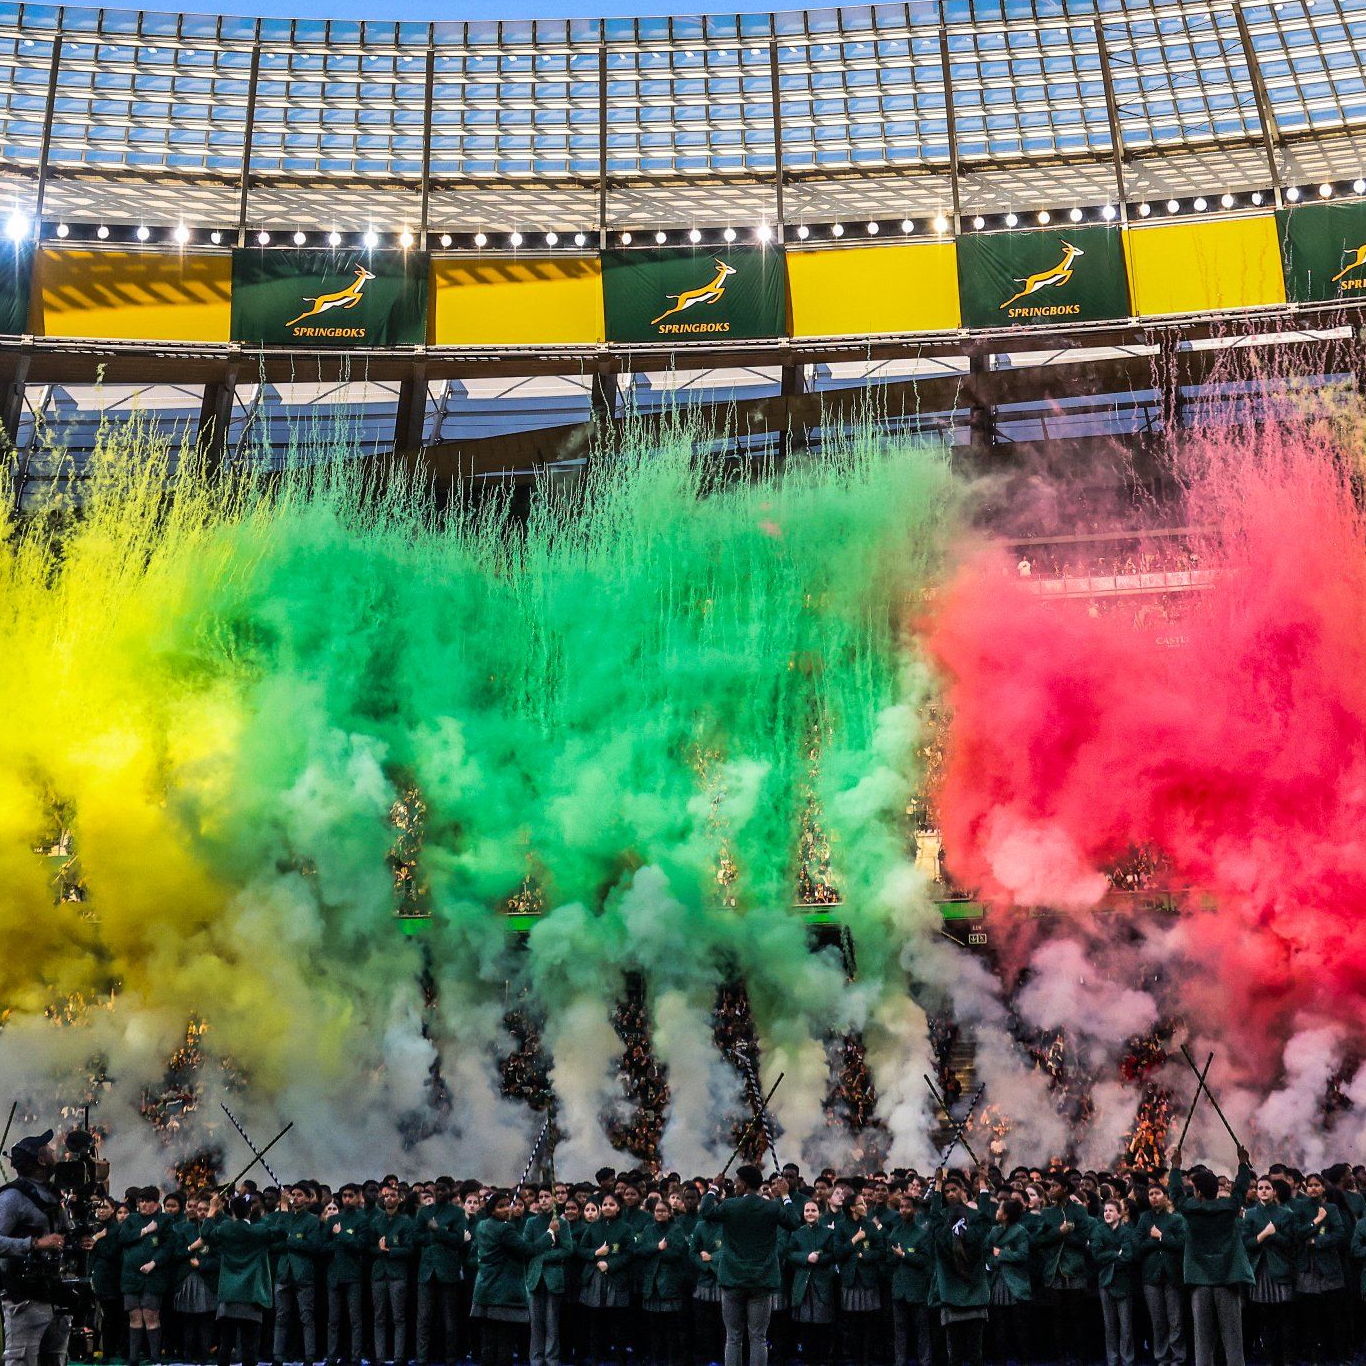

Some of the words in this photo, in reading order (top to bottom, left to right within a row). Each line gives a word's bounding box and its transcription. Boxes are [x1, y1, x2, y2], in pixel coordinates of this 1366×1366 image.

[1008, 305, 1081, 318] SPRINGBOKS
[292, 327, 366, 338] SPRINGBOKS
[658, 322, 730, 334] SPRINGBOKS
